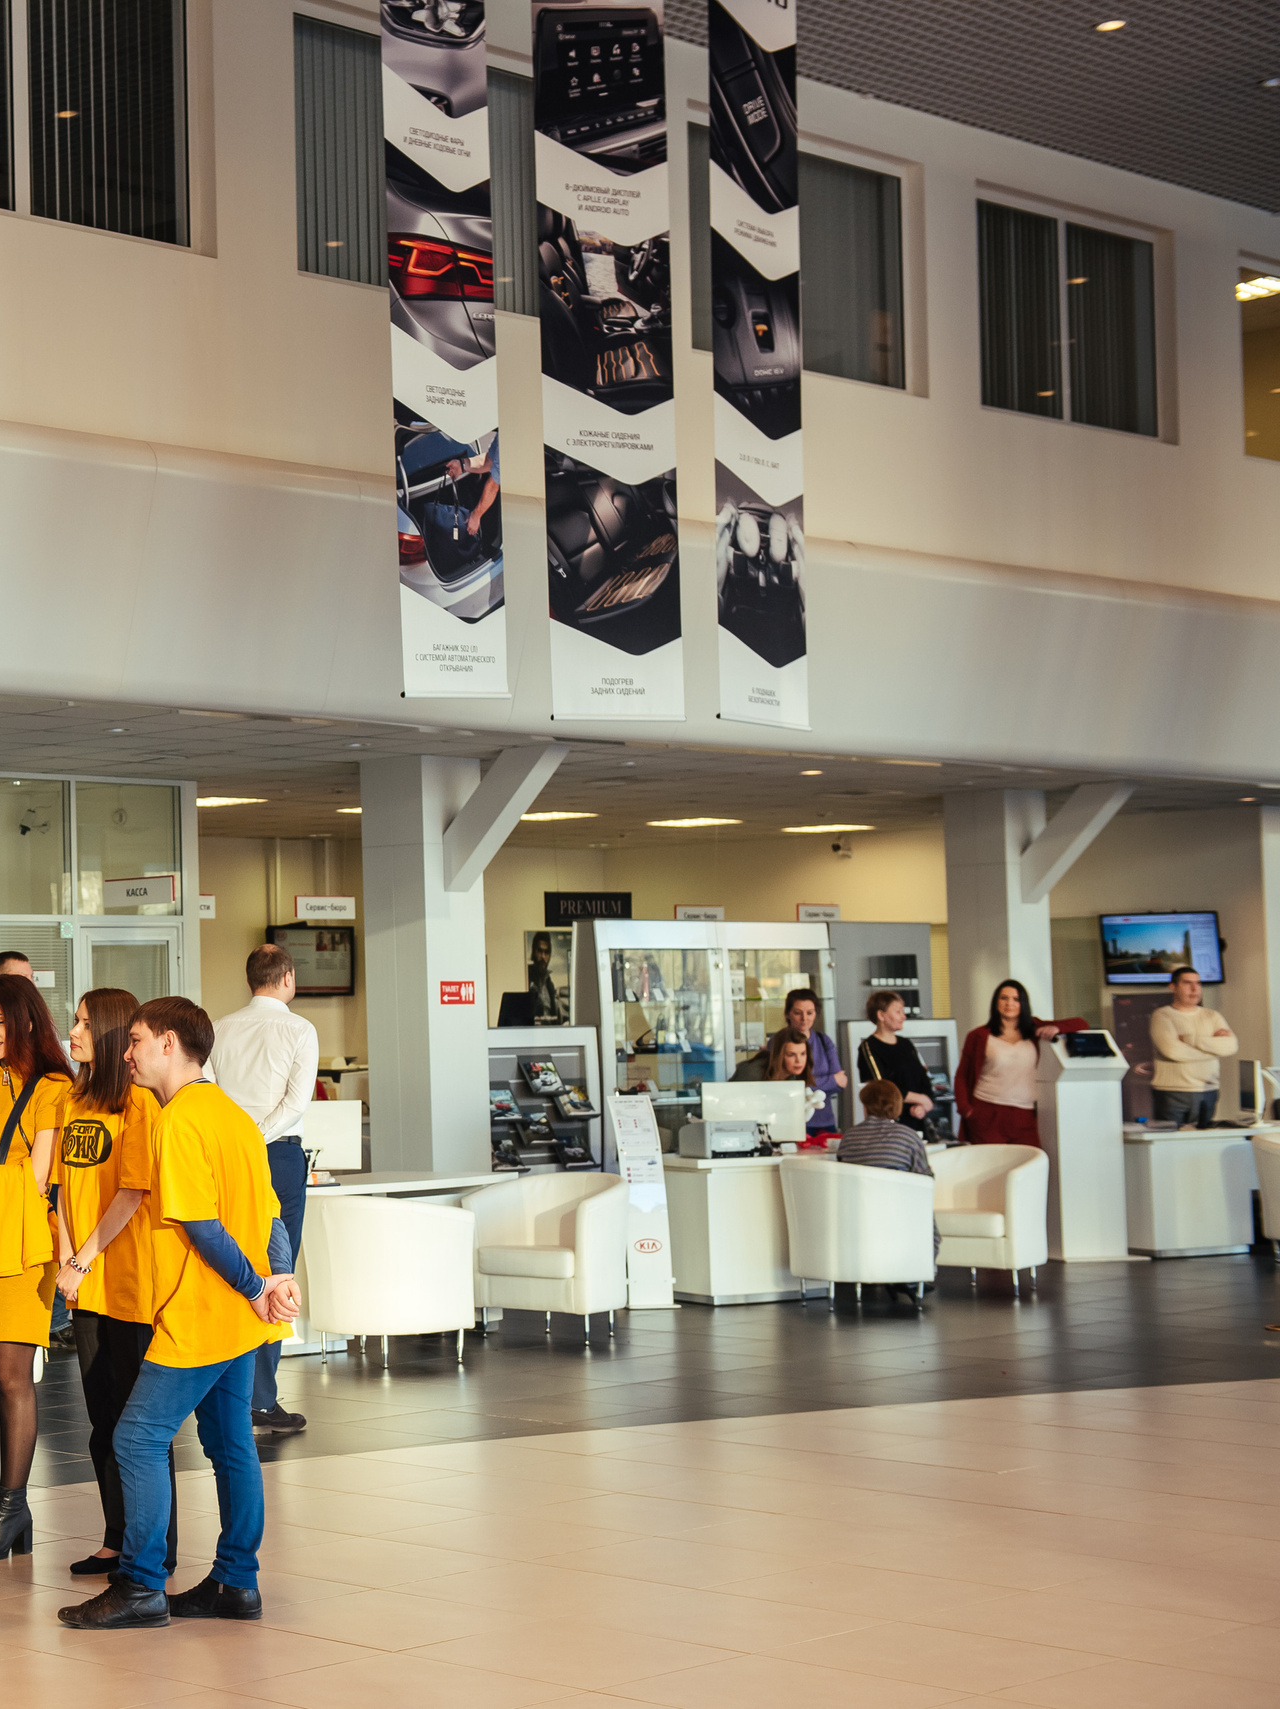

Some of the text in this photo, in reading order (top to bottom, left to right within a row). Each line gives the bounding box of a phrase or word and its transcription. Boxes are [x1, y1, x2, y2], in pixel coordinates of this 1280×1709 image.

[742, 95, 765, 115] DRIVE
[746, 107, 769, 126] MODE
[611, 188, 641, 198] ДИСПЛЕЙ
[584, 205, 612, 214] ANDROID
[613, 208, 630, 216] AUTO
[426, 385, 466, 398] СВЕТОДИОДНЫЕ
[426, 395, 467, 407] ЗАДНИЕ ФОНАРИ
[579, 430, 641, 441] КОЖАНЫЕ СИДЕНИЯ
[566, 438, 654, 451] С ЭЛЕКТРОРЕГУЛИРОВКАМИ
[432, 643, 459, 652] БАГАЖНИК
[460, 644, 470, 653] 502
[420, 653, 447, 662] СИСТЕМОЙ
[448, 654, 496, 664] АВТОМАТИЧЕСКОГО
[439, 664, 473, 673] ОТКРЫВАНИЯ
[601, 677, 634, 686] ПОДОГРЕВ
[591, 686, 646, 696] ЗАДНИХ СИДЕНИЙ
[126, 887, 148, 897] КАССА
[305, 902, 348, 913] Сервис-бюро
[559, 900, 622, 915] PREMIUM
[442, 985, 460, 993] ТУАЛЕТ
[72, 1125, 95, 1134] FORT
[639, 1241, 658, 1250] KIA
